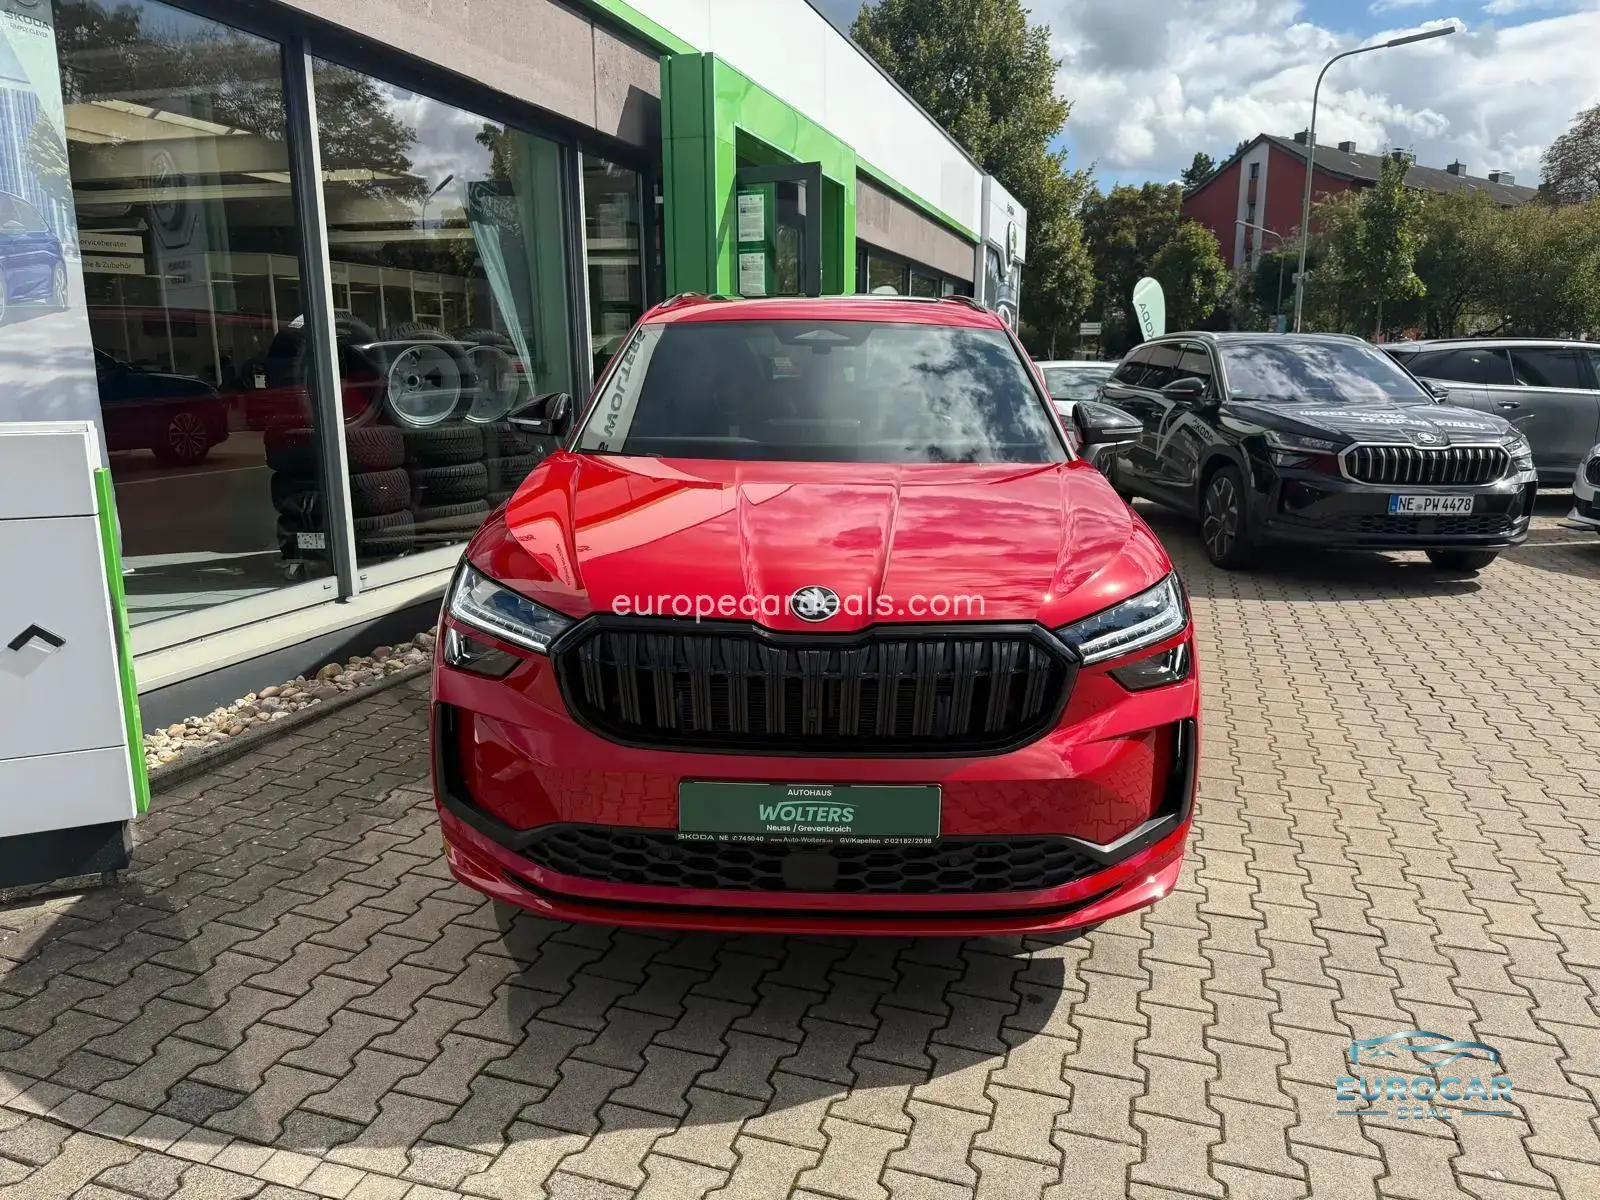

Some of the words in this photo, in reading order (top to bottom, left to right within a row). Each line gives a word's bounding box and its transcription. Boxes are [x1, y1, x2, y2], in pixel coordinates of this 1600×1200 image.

[80, 239, 128, 248] erviceberater
[1398, 497, 1415, 511] NE
[1424, 498, 1440, 511] PW
[1442, 498, 1472, 511] 4478
[787, 789, 832, 797] AUTOHAUS
[759, 801, 855, 823] WOLTERS
[766, 824, 791, 832] Neuss
